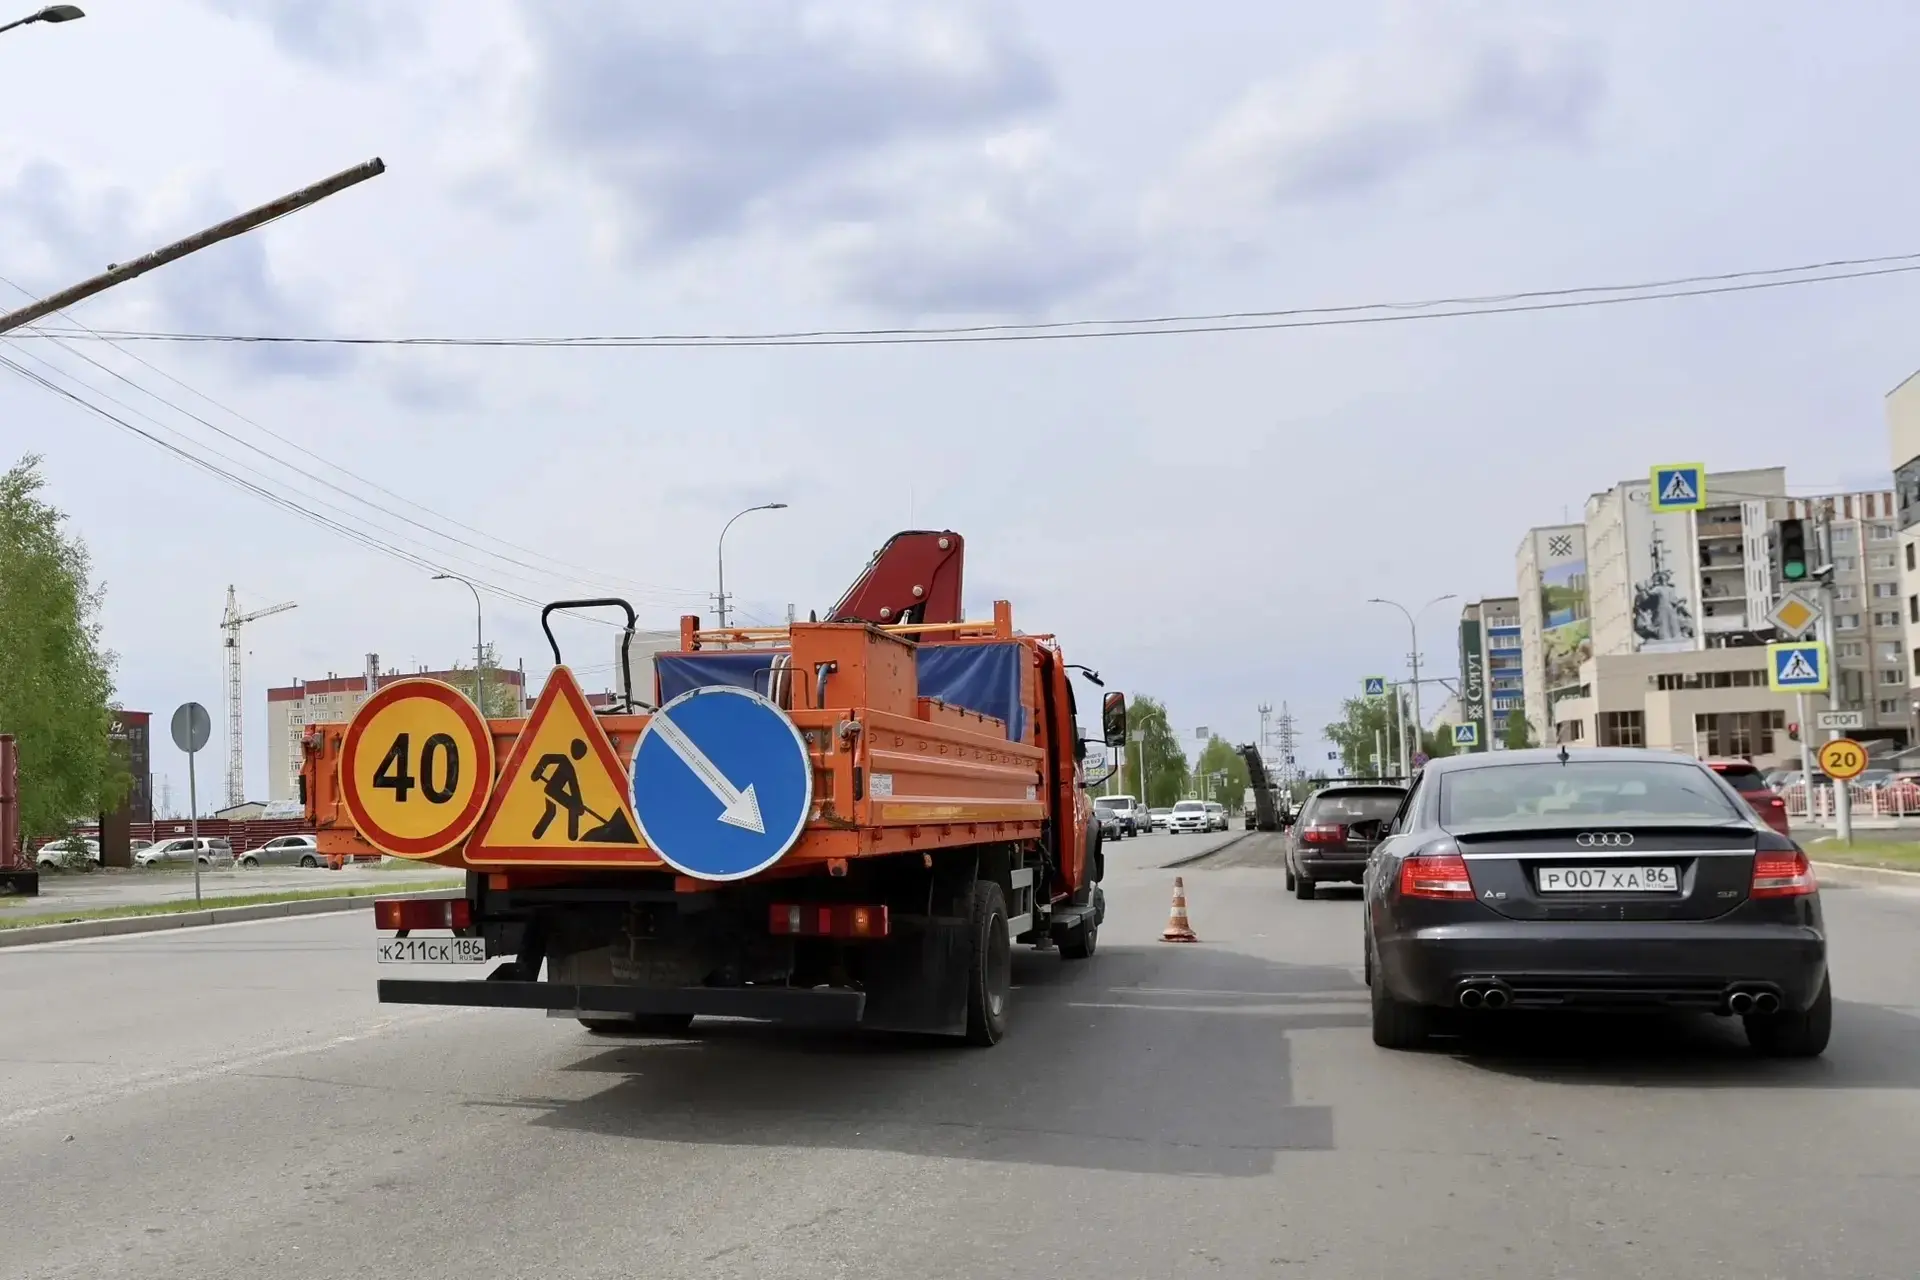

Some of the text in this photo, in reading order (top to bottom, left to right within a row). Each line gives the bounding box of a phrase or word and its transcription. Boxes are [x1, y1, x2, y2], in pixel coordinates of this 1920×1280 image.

[1822, 714, 1858, 726] СТОП
[1829, 751, 1857, 768] 20
[372, 732, 460, 805] 40
[1646, 868, 1668, 883] 86
[454, 940, 480, 955] 186
